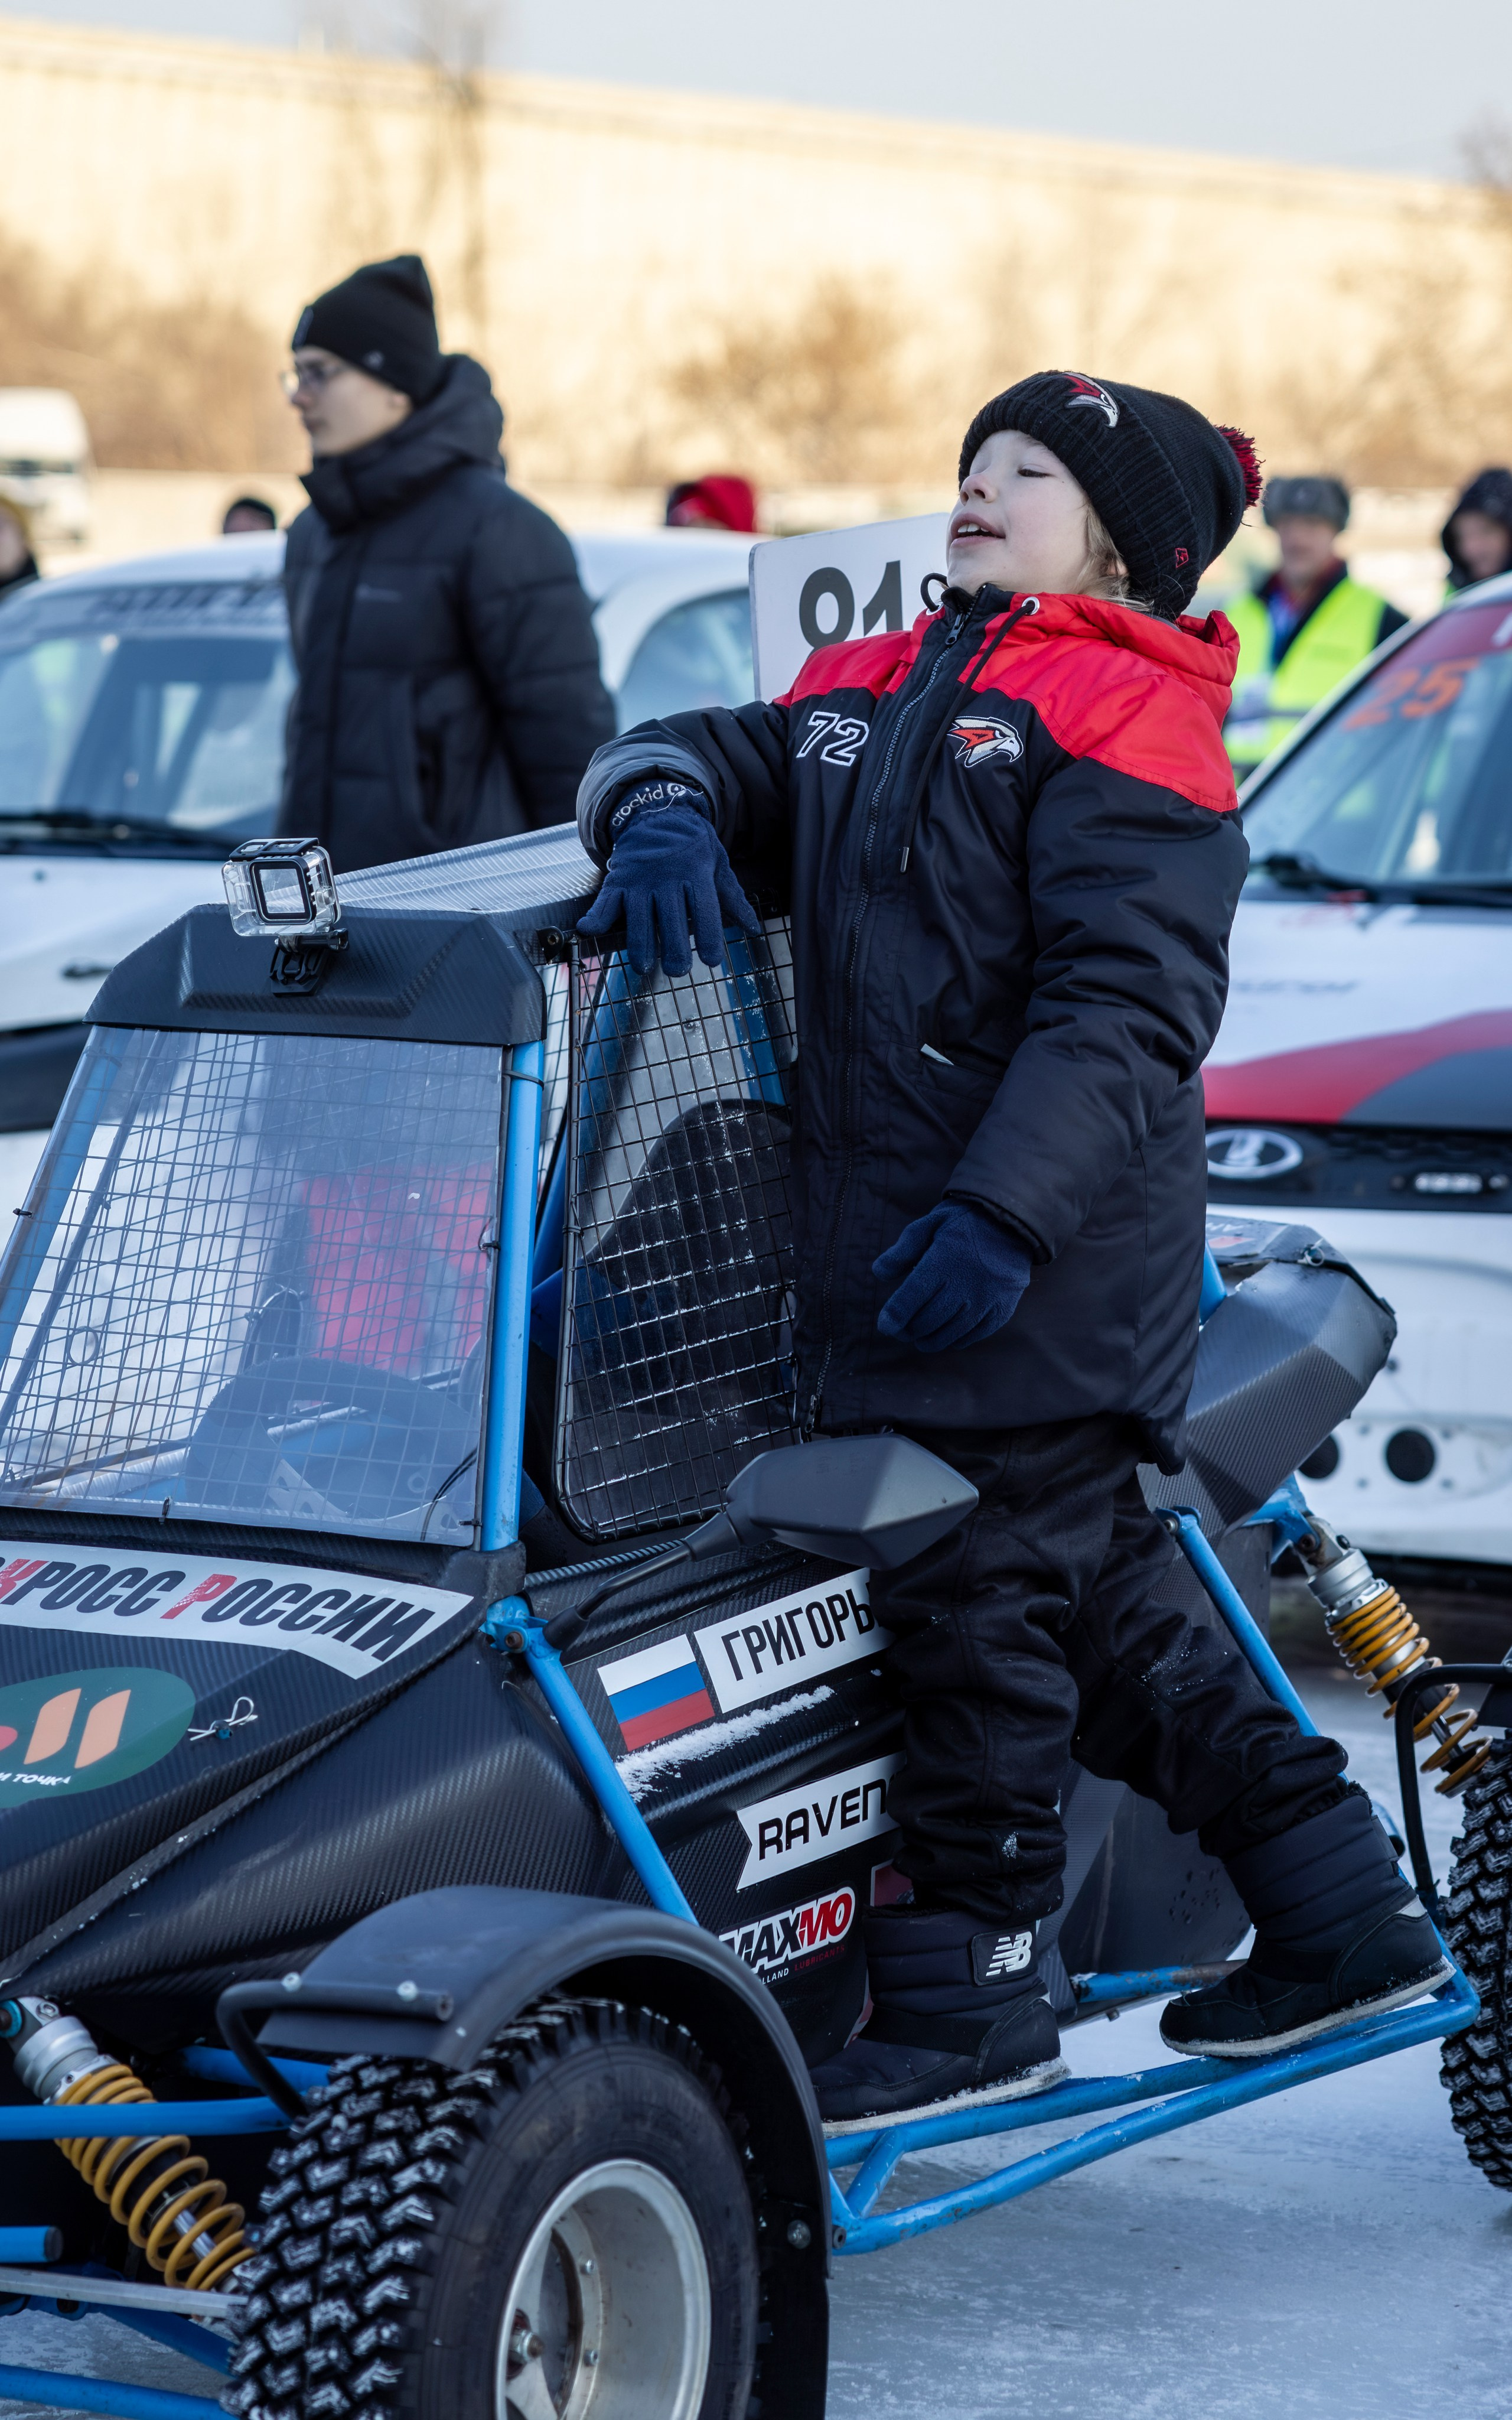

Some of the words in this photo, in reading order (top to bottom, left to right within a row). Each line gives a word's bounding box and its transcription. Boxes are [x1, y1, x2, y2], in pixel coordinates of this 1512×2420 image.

[1340, 658, 1479, 733] 25
[796, 711, 869, 767] 72
[612, 783, 664, 827] crockid
[0, 1557, 186, 1616] КРОСС
[159, 1573, 436, 1662] РОССИИ
[721, 1582, 875, 1681] ГРИГОРЬ
[12, 1773, 71, 1786] ТОЧКА
[758, 1774, 894, 1861] RAVEN
[760, 1967, 789, 1985] LLAND
[794, 1944, 845, 1972] LUBRICANTS
